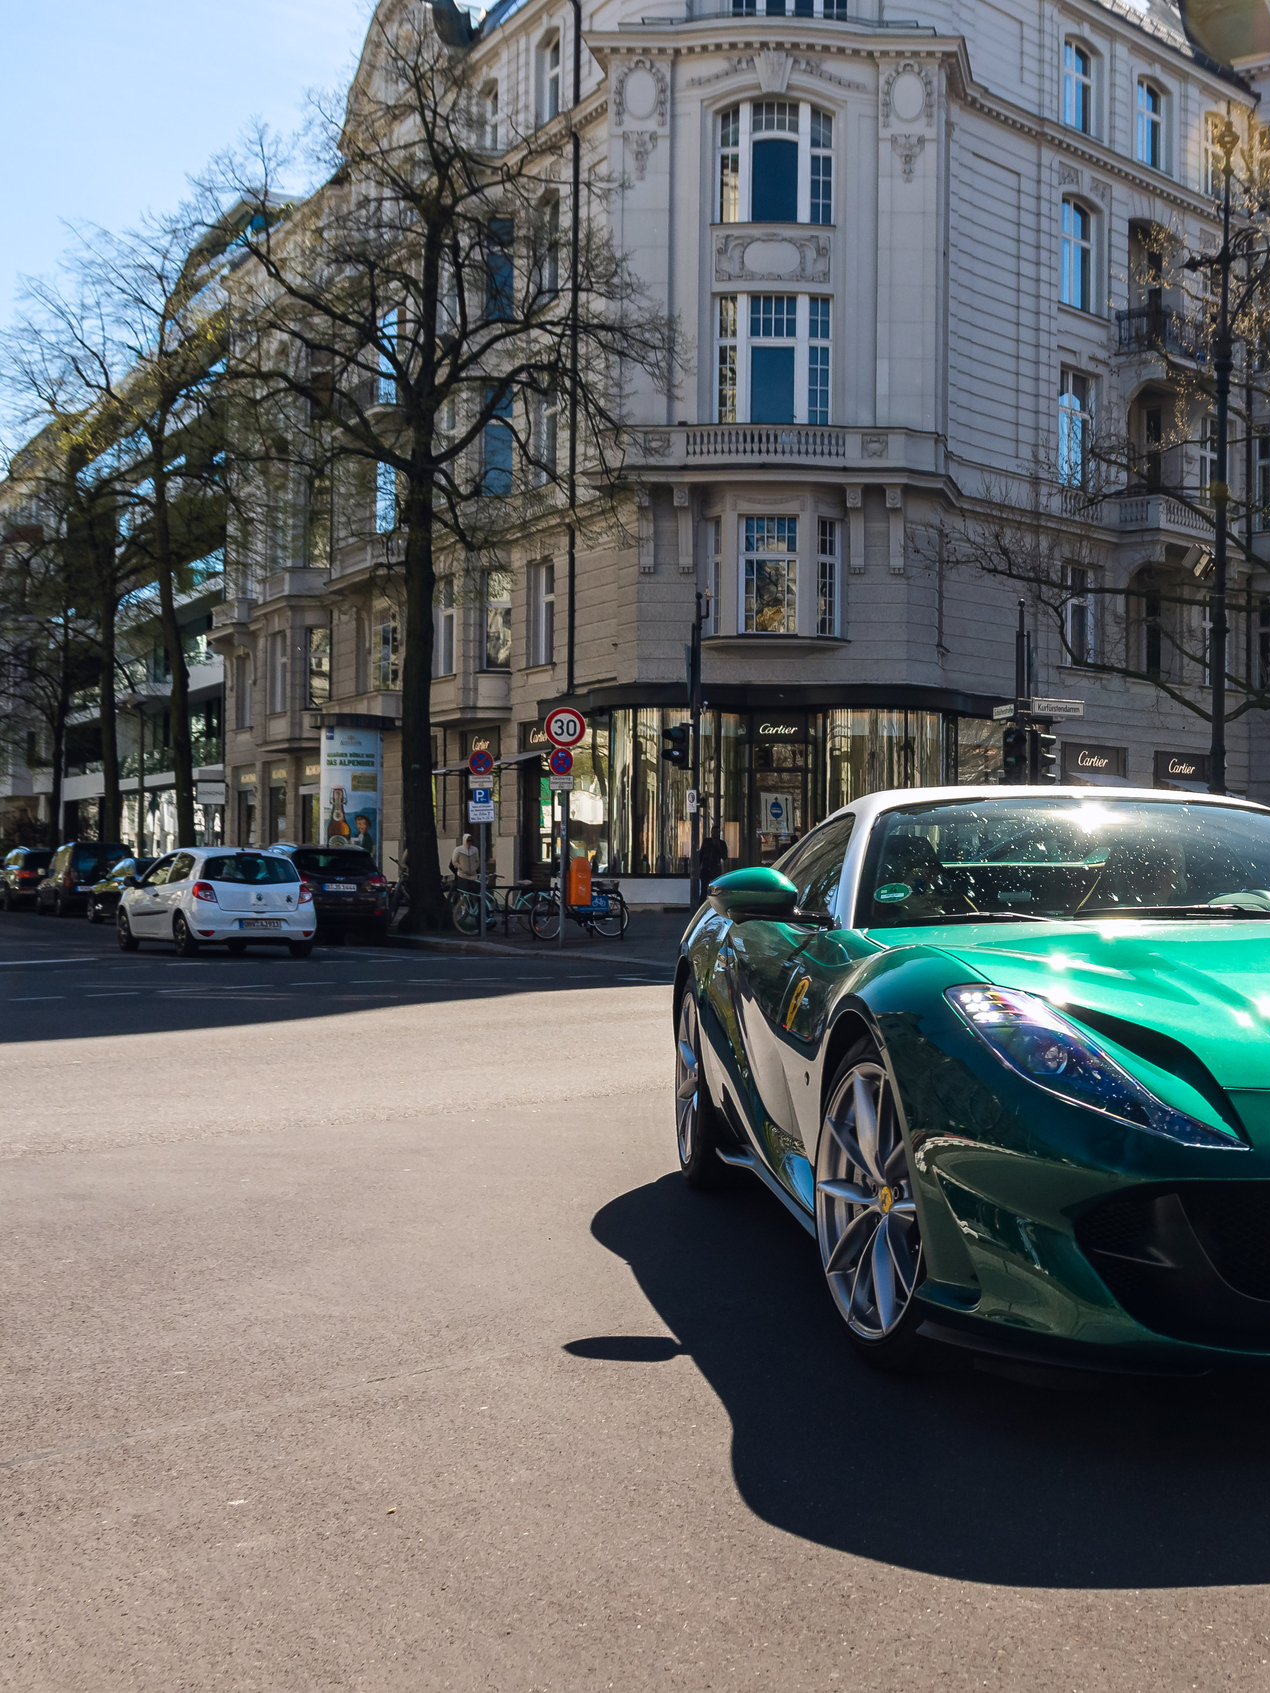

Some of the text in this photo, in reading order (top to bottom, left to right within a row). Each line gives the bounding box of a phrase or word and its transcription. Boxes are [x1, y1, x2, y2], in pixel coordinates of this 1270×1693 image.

[1037, 703, 1080, 713] Kurfürstendamm
[554, 719, 577, 737] 30
[759, 723, 798, 735] Cartier
[472, 736, 490, 751] Cartier
[1078, 750, 1109, 768] Cartier
[1168, 758, 1196, 774] Cartier
